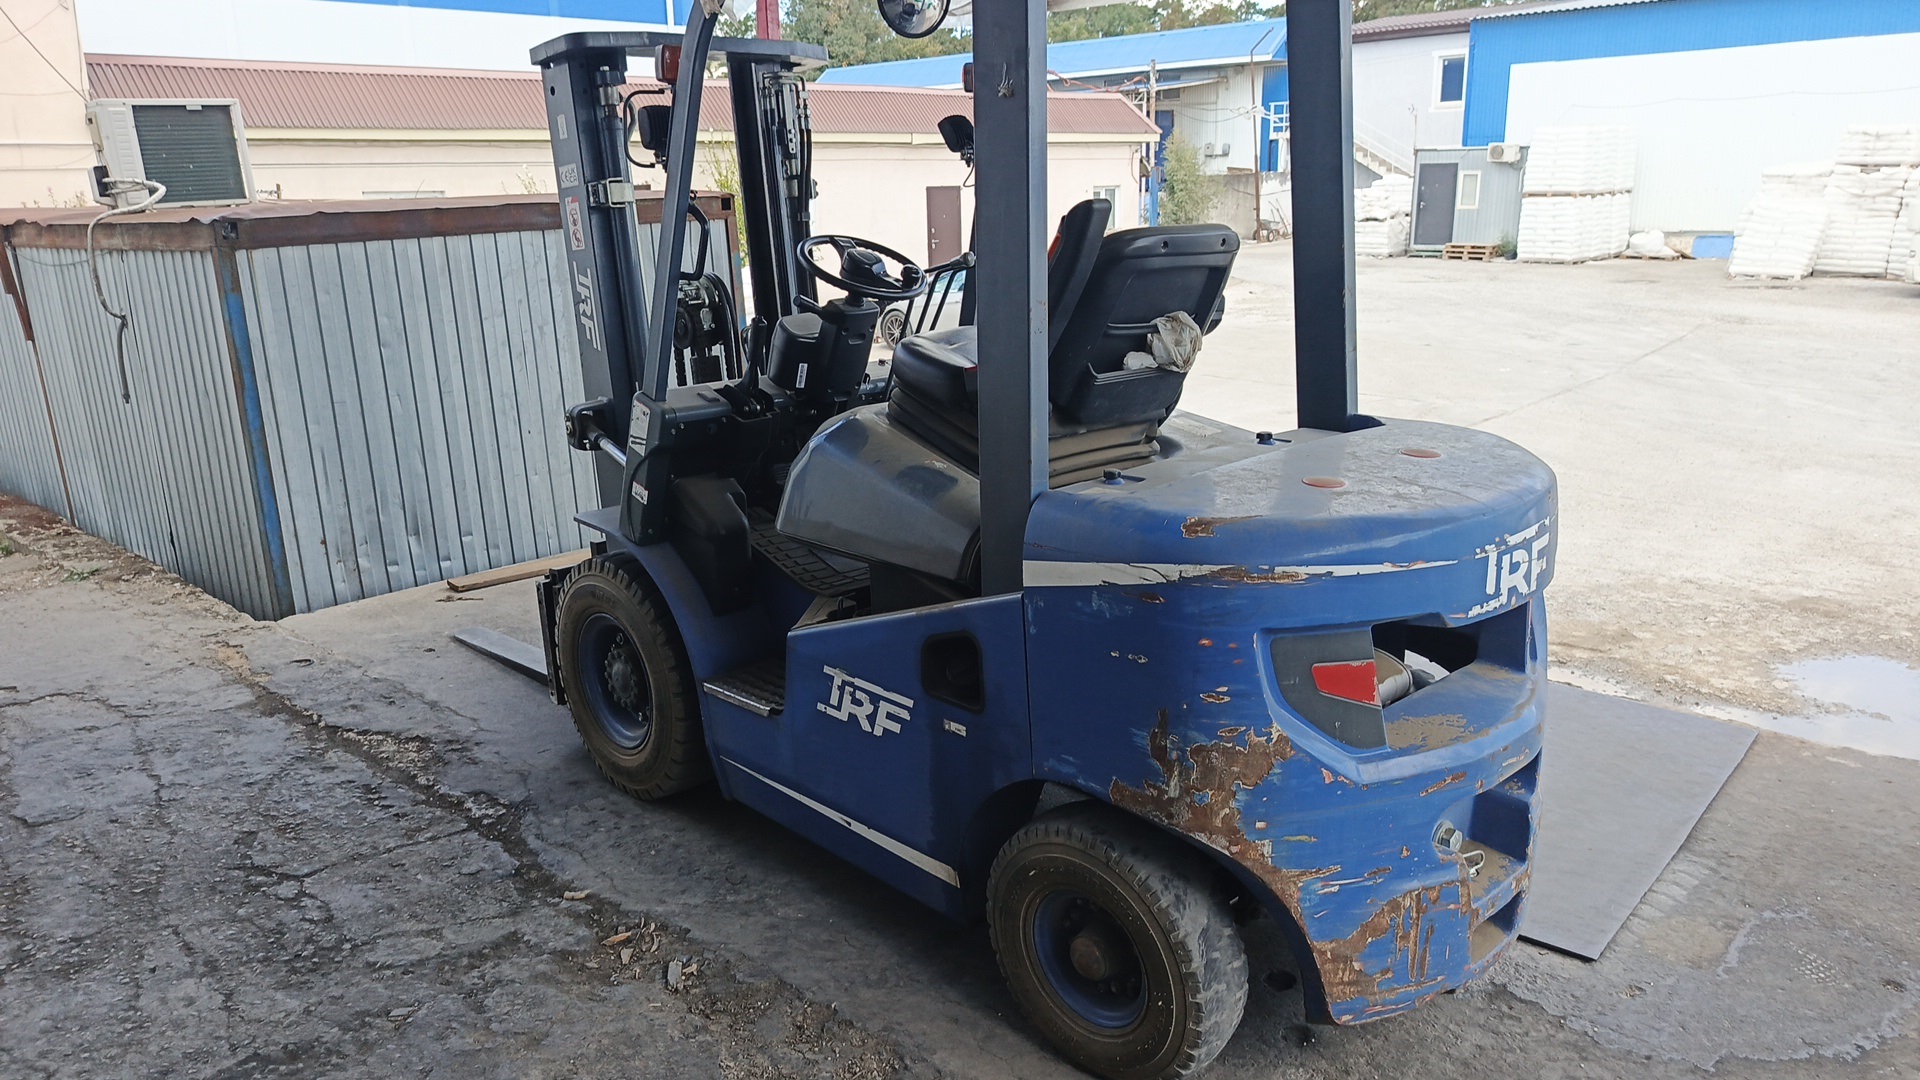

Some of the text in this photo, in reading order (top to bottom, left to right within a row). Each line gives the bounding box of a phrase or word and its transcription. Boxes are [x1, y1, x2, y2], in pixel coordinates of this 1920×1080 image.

[561, 170, 569, 183] CE
[572, 261, 602, 351] TRF
[1467, 516, 1550, 618] TRF
[816, 664, 914, 737] TRF
